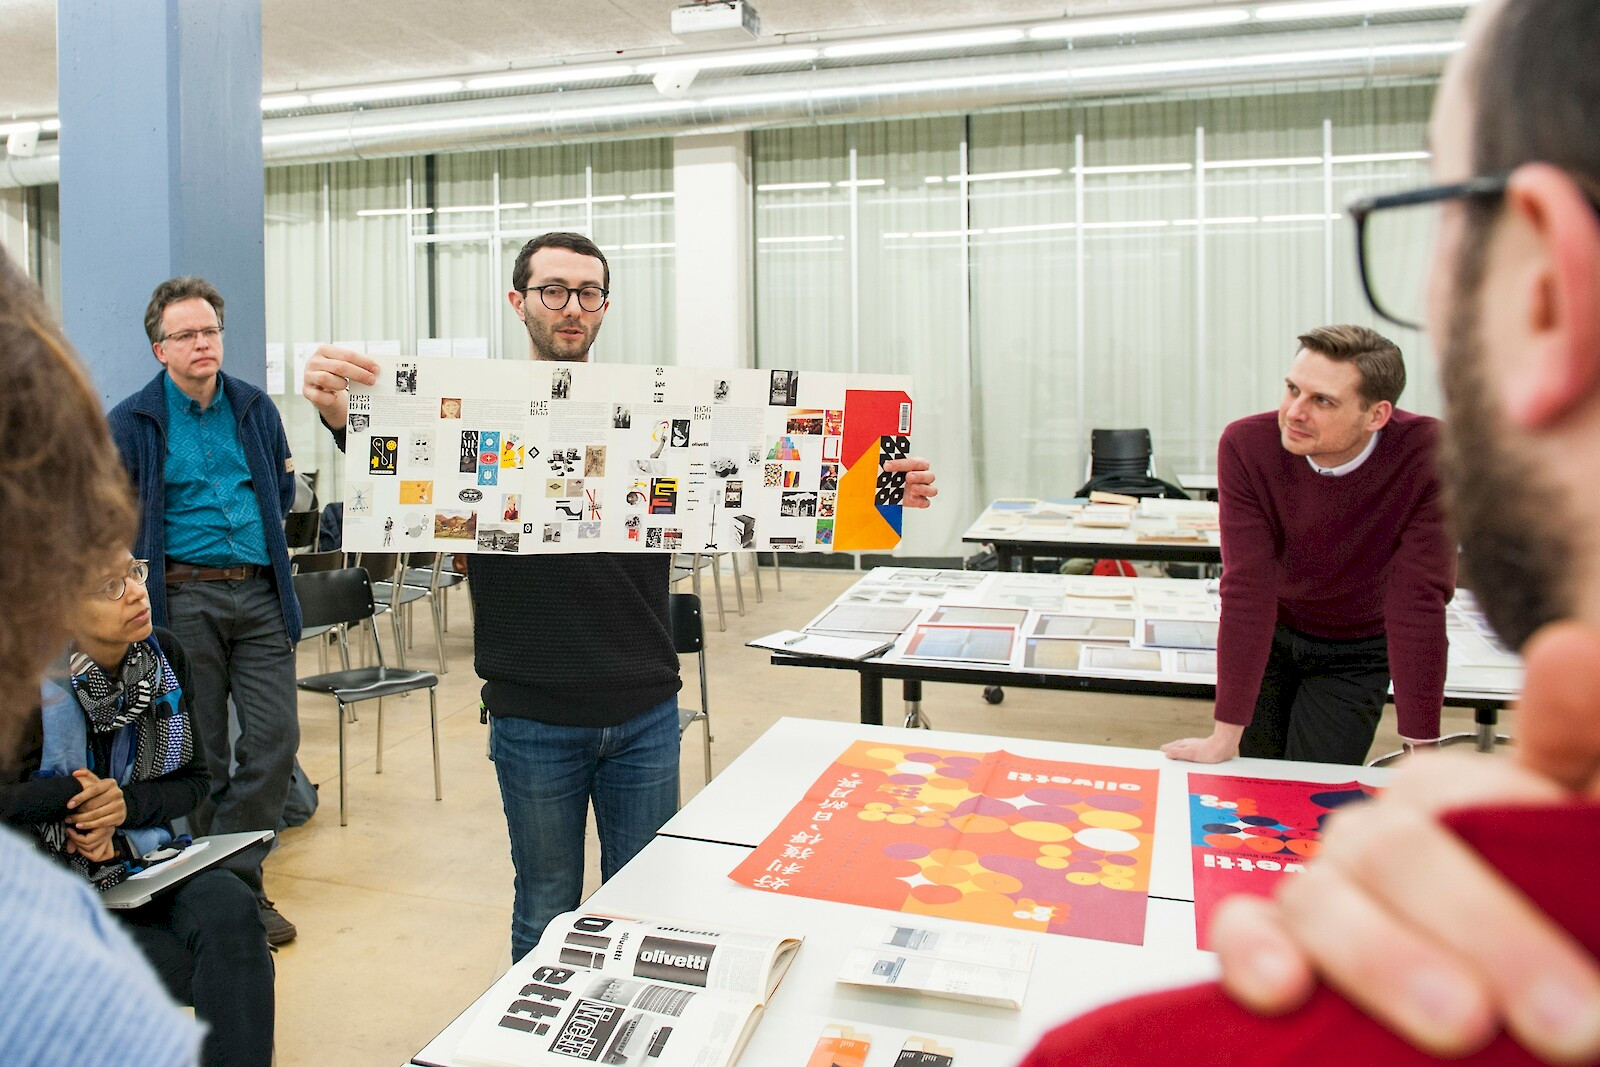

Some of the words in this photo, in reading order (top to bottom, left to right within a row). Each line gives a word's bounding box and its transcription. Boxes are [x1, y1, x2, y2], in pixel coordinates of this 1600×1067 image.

[1007, 771, 1141, 792] olivetti
[1203, 854, 1307, 873] vetti
[613, 932, 630, 960] olivetti
[640, 949, 708, 970] olivetti
[498, 917, 614, 1036] olietti
